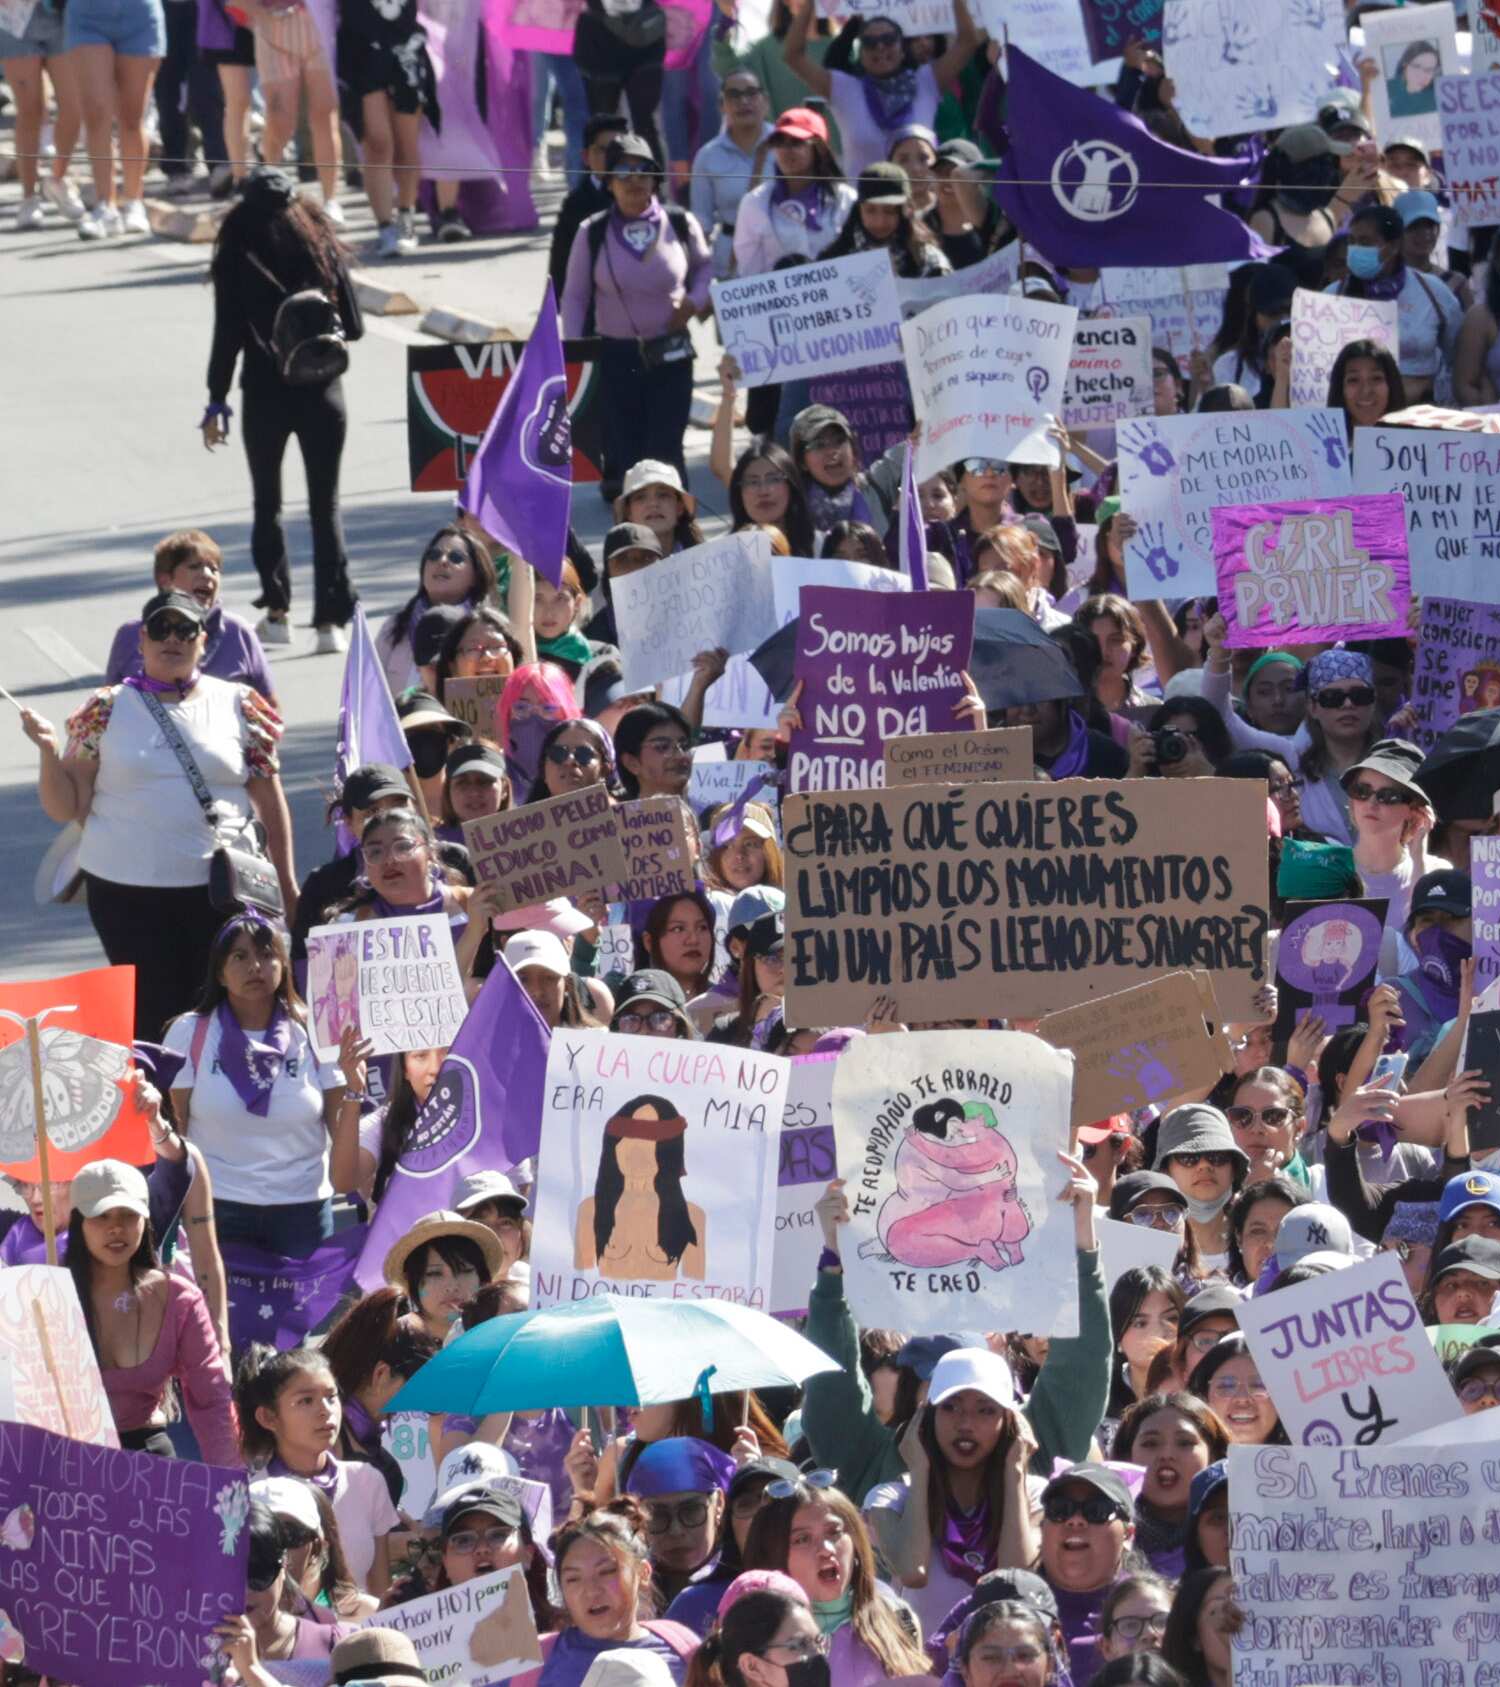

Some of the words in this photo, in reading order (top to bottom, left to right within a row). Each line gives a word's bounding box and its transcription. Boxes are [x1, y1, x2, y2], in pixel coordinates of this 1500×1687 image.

[1440, 80, 1474, 113] SE
[1446, 118, 1482, 141] POR
[1469, 145, 1499, 167] NO
[721, 282, 777, 302] OCUPAR
[784, 266, 838, 291] ESPACIOS
[722, 293, 799, 320] DOMINADOS
[802, 289, 829, 303] POR
[855, 304, 872, 318] ES
[1076, 373, 1134, 393] hecho
[1215, 425, 1252, 445] EN
[1186, 440, 1294, 472] MEMORIA
[1476, 484, 1496, 505] LE
[1410, 510, 1423, 529] A
[1432, 508, 1459, 529] MI
[1436, 538, 1471, 561] QUE
[1233, 564, 1398, 626] POWER
[805, 614, 894, 658] Somos
[901, 625, 955, 666] hijas
[828, 663, 855, 694] de
[869, 664, 886, 692] la
[816, 704, 864, 738] NO
[648, 829, 672, 847] NO
[788, 794, 892, 857] ¿PARA
[904, 790, 967, 850] QUÉ
[975, 791, 1137, 850] QUIERES
[479, 840, 556, 879] EDUCO
[937, 859, 1000, 908] LOS
[1006, 855, 1232, 909] MONUMENTOS
[363, 925, 437, 961] ESTAR
[793, 928, 839, 986] EN
[846, 928, 892, 984] UN
[900, 912, 981, 981] PAÍS
[991, 916, 1092, 972] LLENO
[1093, 918, 1135, 966] DE
[382, 961, 457, 993] SUERTE
[370, 999, 396, 1027] ES
[566, 1042, 584, 1071] Y
[598, 1047, 630, 1079] LA
[648, 1051, 726, 1084] CULPA
[738, 1061, 778, 1095] NO
[911, 1073, 937, 1098] TE
[942, 1068, 1012, 1105] ABRAZO
[553, 1086, 604, 1111] ERA
[704, 1098, 767, 1132] MIA
[537, 1272, 561, 1300] NI
[889, 1270, 916, 1292] TE
[1260, 1279, 1416, 1360] JUNTAS
[1293, 1335, 1415, 1403] LIBRES
[39, 1432, 211, 1508] MEMORIA
[1255, 1447, 1317, 1499] Si
[1332, 1449, 1471, 1499] tienes
[30, 1484, 108, 1522] TODAS
[129, 1500, 190, 1536] LAS
[41, 1526, 156, 1575] NIÑAS
[1382, 1509, 1451, 1560] hija
[54, 1569, 110, 1607] QUE
[129, 1582, 163, 1620] NO
[1349, 1570, 1390, 1601] es
[436, 1588, 471, 1621] HOY
[15, 1599, 200, 1669] CREYERON
[1232, 1604, 1442, 1661] comprender
